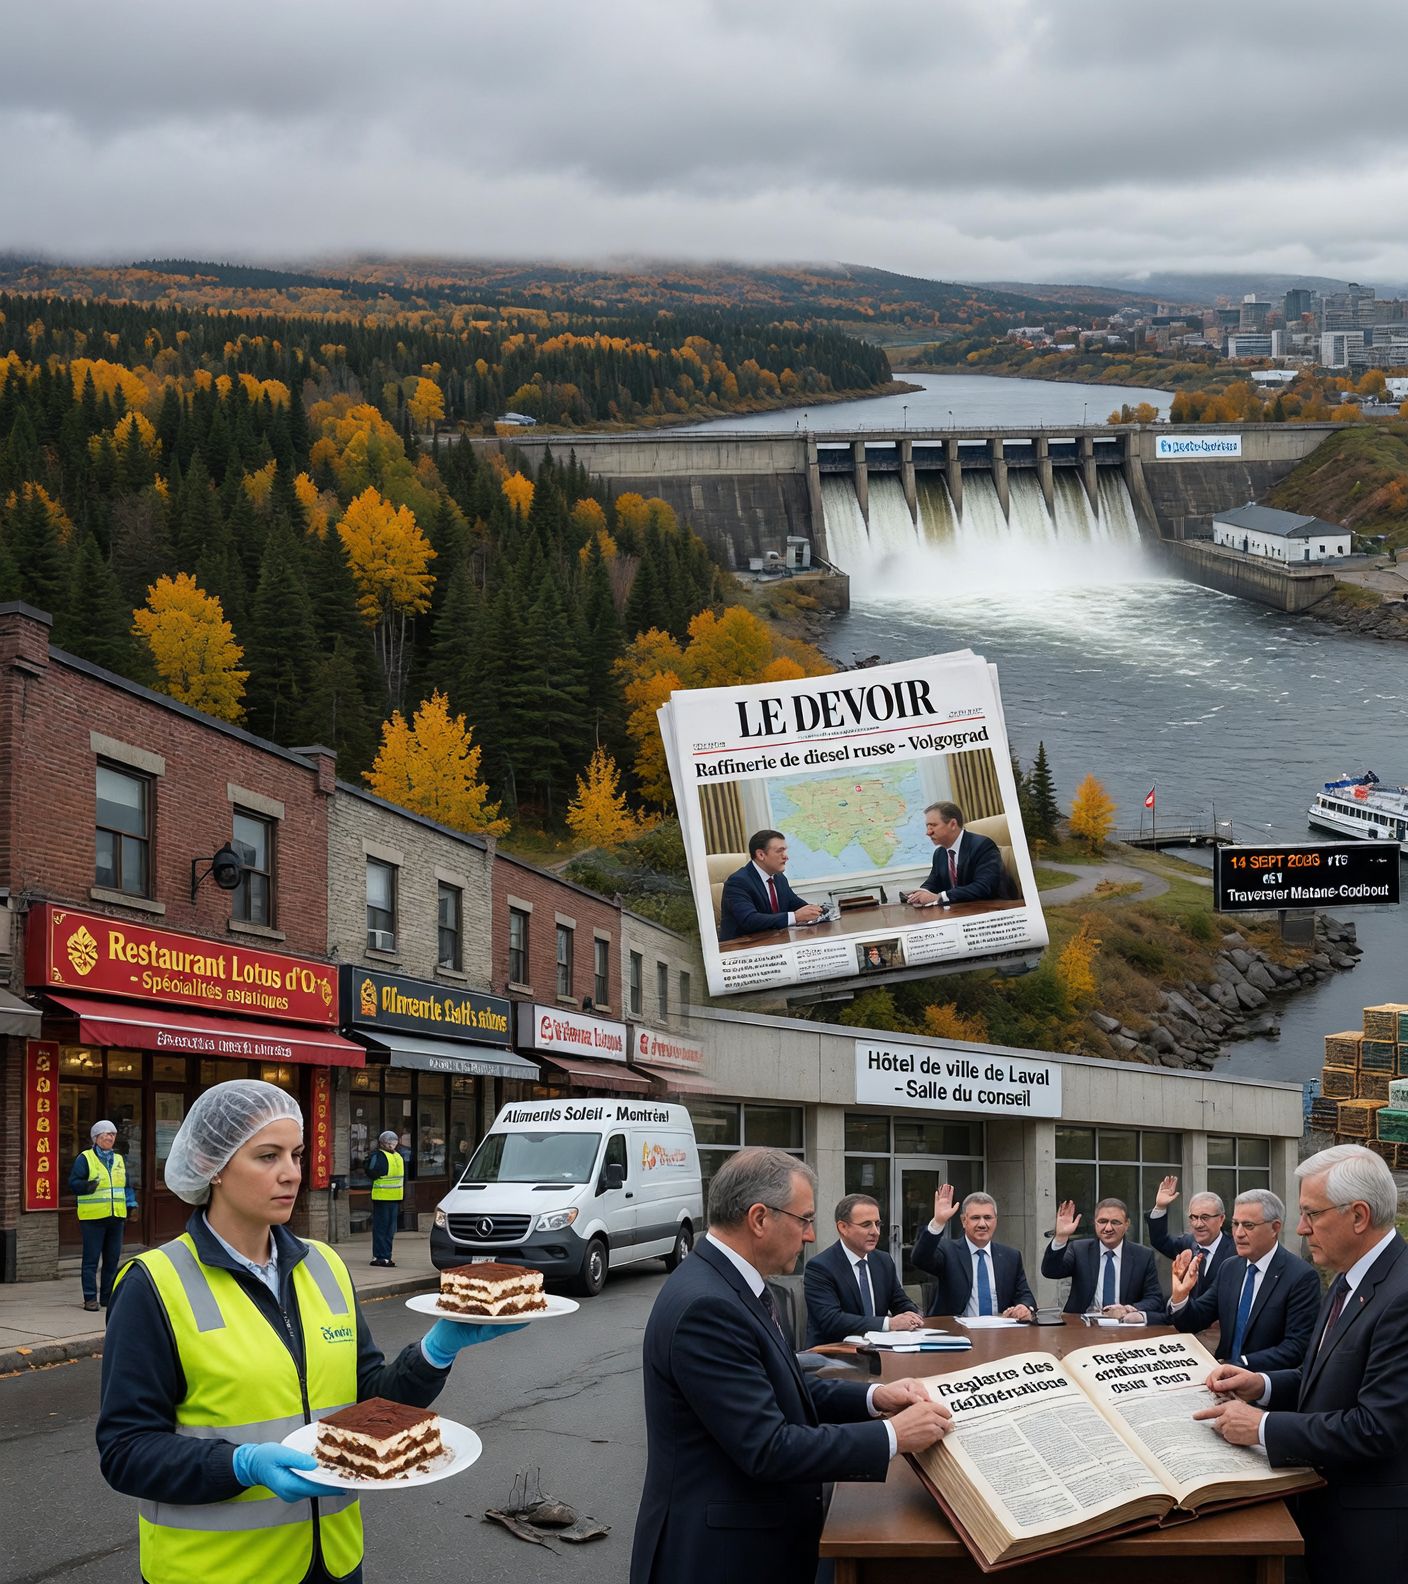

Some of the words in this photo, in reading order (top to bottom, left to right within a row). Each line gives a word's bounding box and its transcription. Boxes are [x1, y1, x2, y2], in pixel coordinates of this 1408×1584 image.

[735, 698, 787, 739] LE
[795, 678, 939, 733] DEVOIR
[694, 755, 777, 778] Raffinerie
[780, 752, 800, 768] de
[803, 745, 850, 765] diesel
[853, 742, 896, 759] russe
[907, 725, 990, 751] Volgograd
[1230, 856, 1247, 869] 14
[1249, 855, 1286, 869] SEPT
[108, 931, 227, 979] Restaurant
[232, 955, 282, 989] Lotus
[868, 1050, 915, 1073] Hôtel
[920, 1056, 941, 1075] de
[946, 1059, 979, 1079] ville
[984, 1063, 1005, 1082] de
[1009, 1065, 1050, 1086] Laval
[906, 1079, 947, 1100] Salle
[952, 1084, 972, 1102] du
[977, 1089, 1031, 1107] conseil
[1158, 1342, 1187, 1355] des
[1022, 1361, 1055, 1375] des
